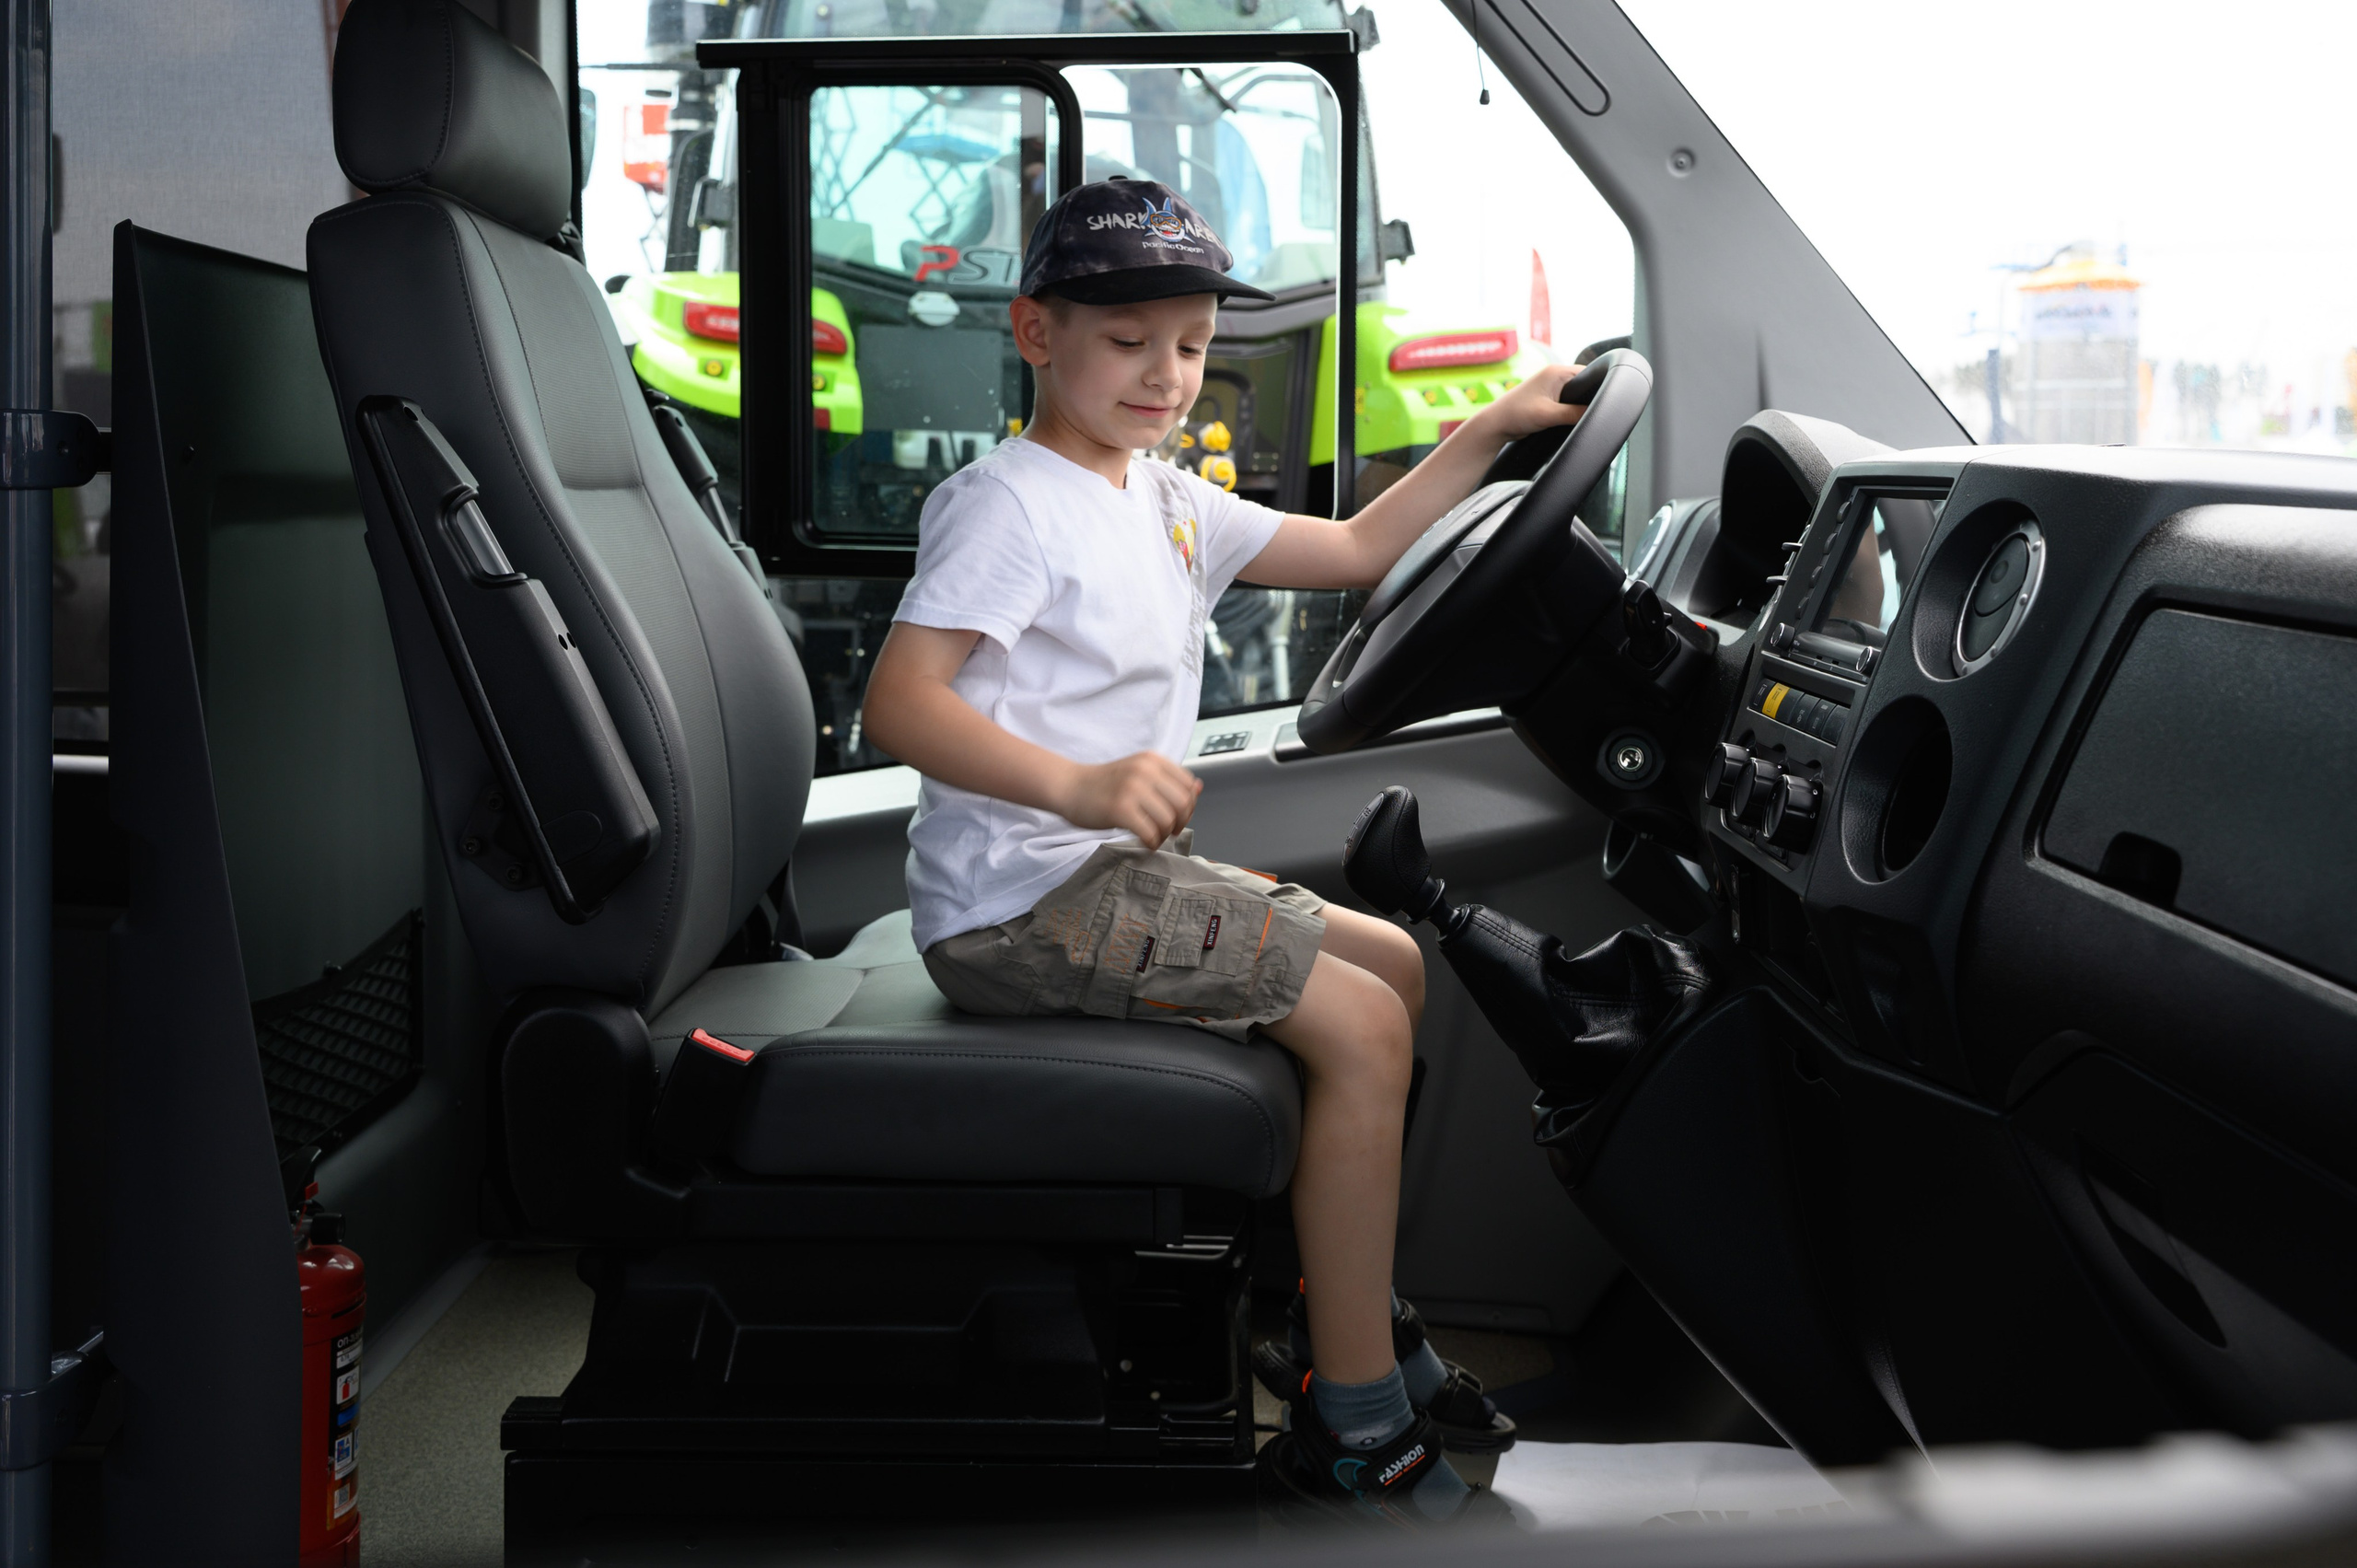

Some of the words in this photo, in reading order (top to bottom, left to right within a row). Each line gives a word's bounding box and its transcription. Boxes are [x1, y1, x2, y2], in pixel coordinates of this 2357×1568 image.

[1176, 244, 1204, 255] Ocean
[1206, 918, 1218, 947] XINFENG
[1377, 1444, 1426, 1483] FASHION
